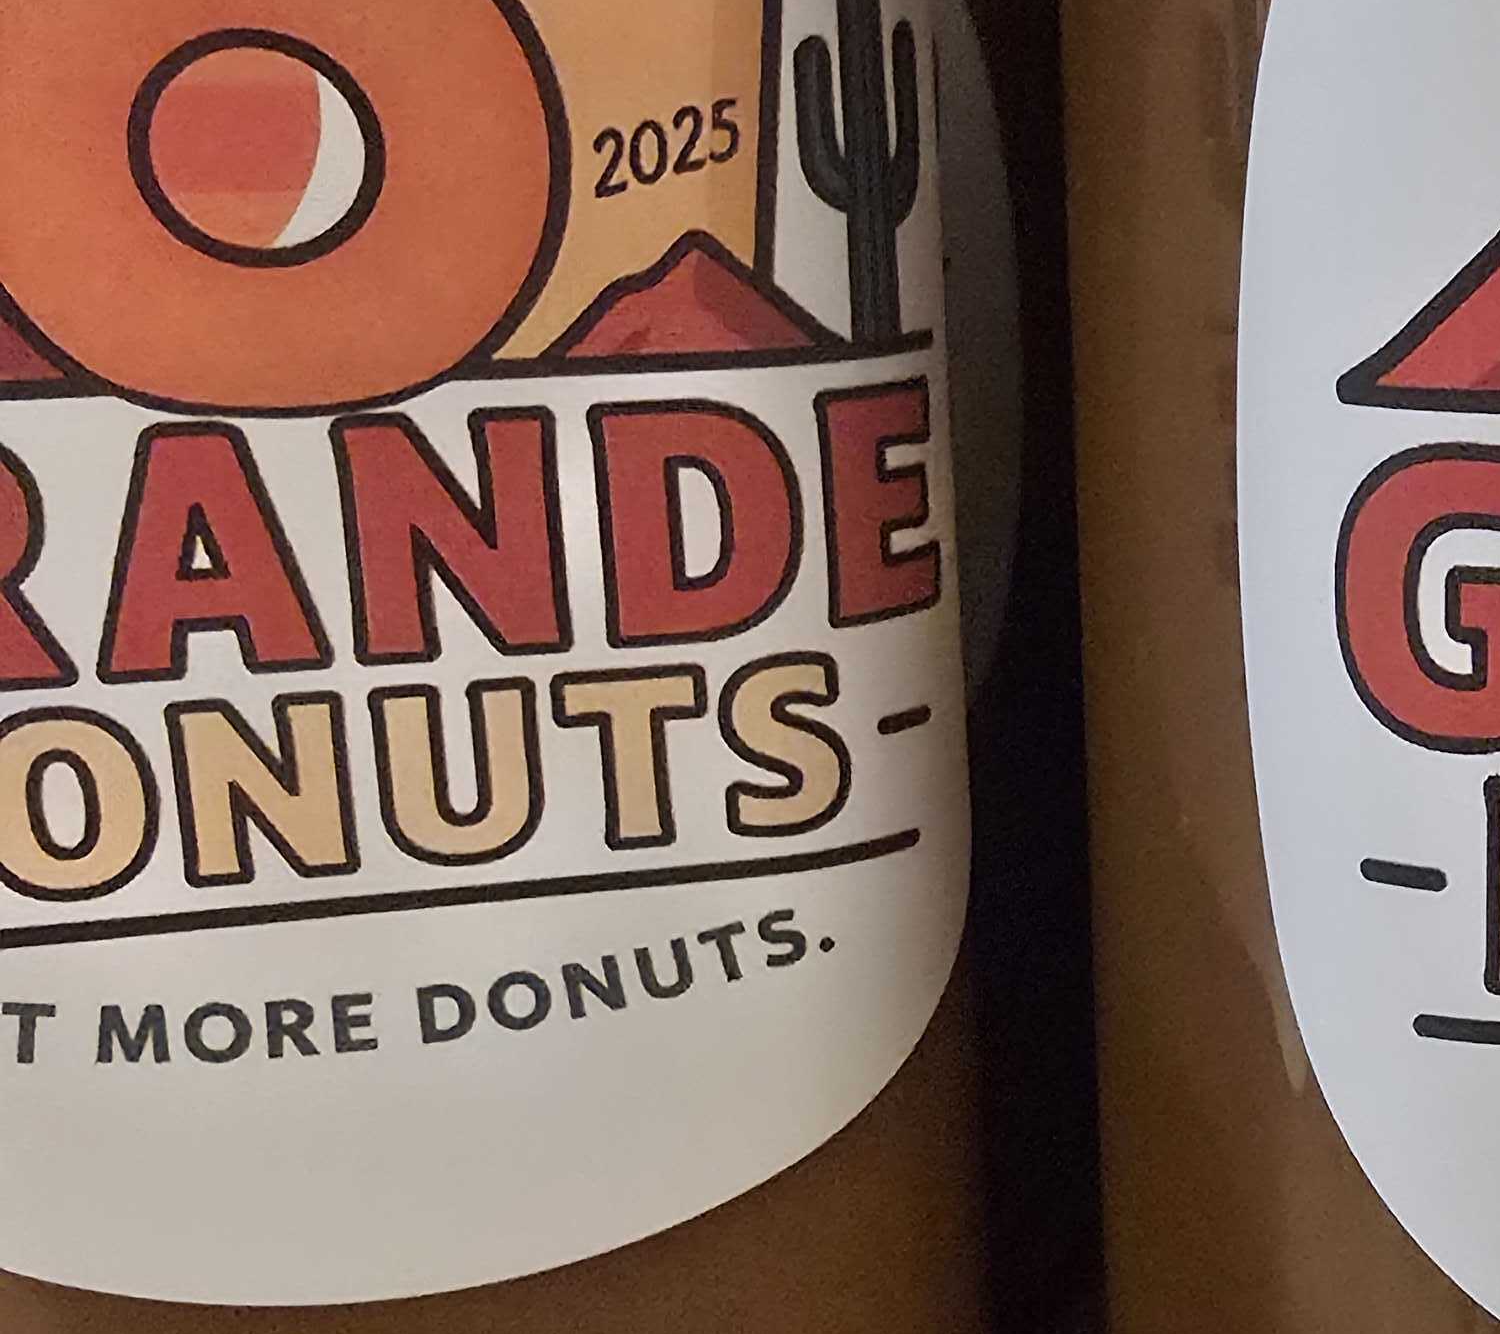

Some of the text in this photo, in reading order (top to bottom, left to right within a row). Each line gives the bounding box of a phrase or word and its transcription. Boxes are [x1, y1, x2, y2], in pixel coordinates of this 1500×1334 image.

[593, 98, 741, 198] 2025
[96, 993, 378, 1064] MORE
[415, 907, 836, 1046] DONUTS.
